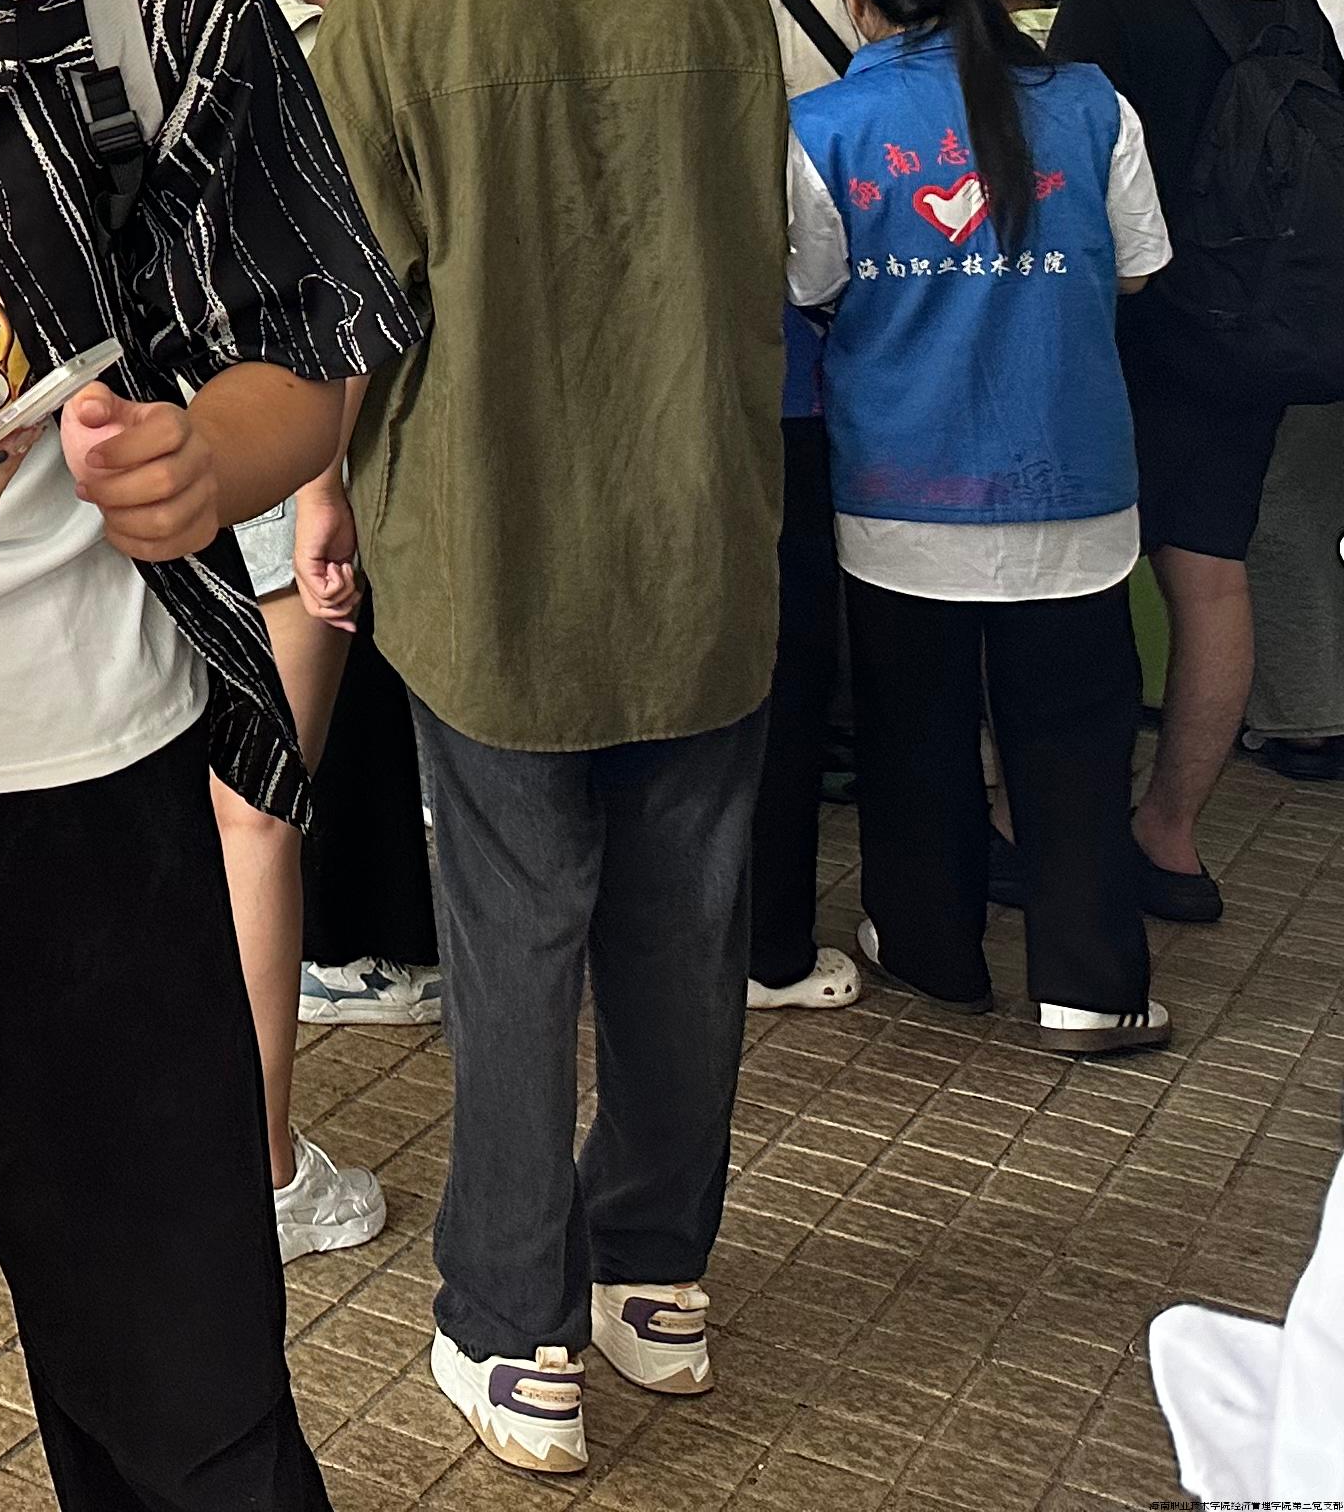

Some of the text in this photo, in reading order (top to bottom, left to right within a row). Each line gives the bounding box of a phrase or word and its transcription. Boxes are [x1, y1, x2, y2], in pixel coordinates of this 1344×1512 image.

[857, 249, 1069, 281] 海南职业技术学院
